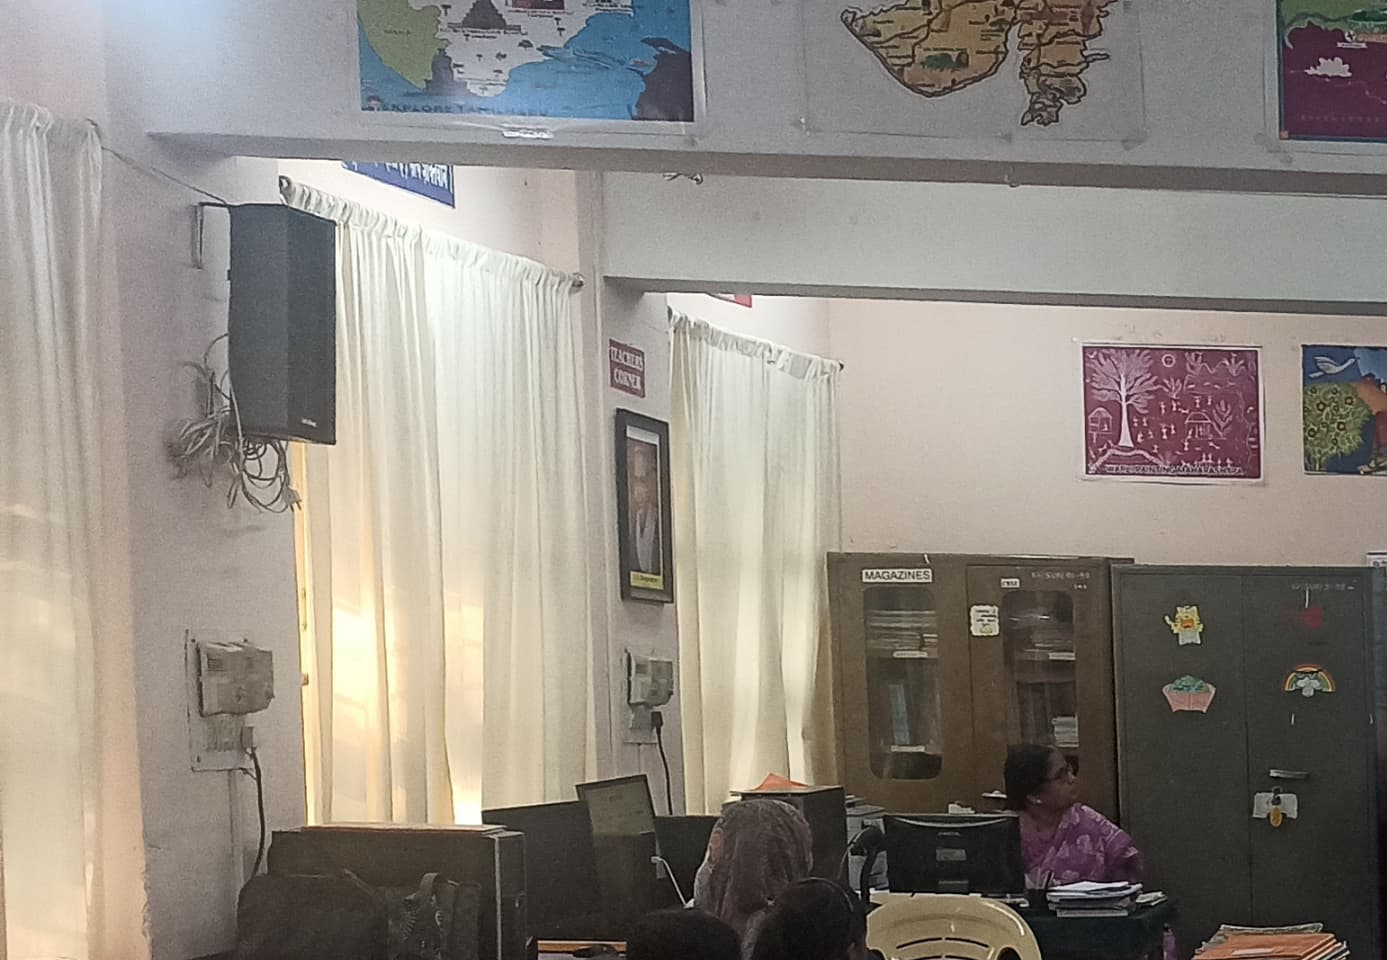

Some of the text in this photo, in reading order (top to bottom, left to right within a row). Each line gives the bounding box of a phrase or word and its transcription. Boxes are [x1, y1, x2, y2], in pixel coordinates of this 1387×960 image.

[610, 346, 644, 370] TEACHERS
[614, 367, 641, 390] CORNER
[864, 570, 931, 580] MAGAZINES
